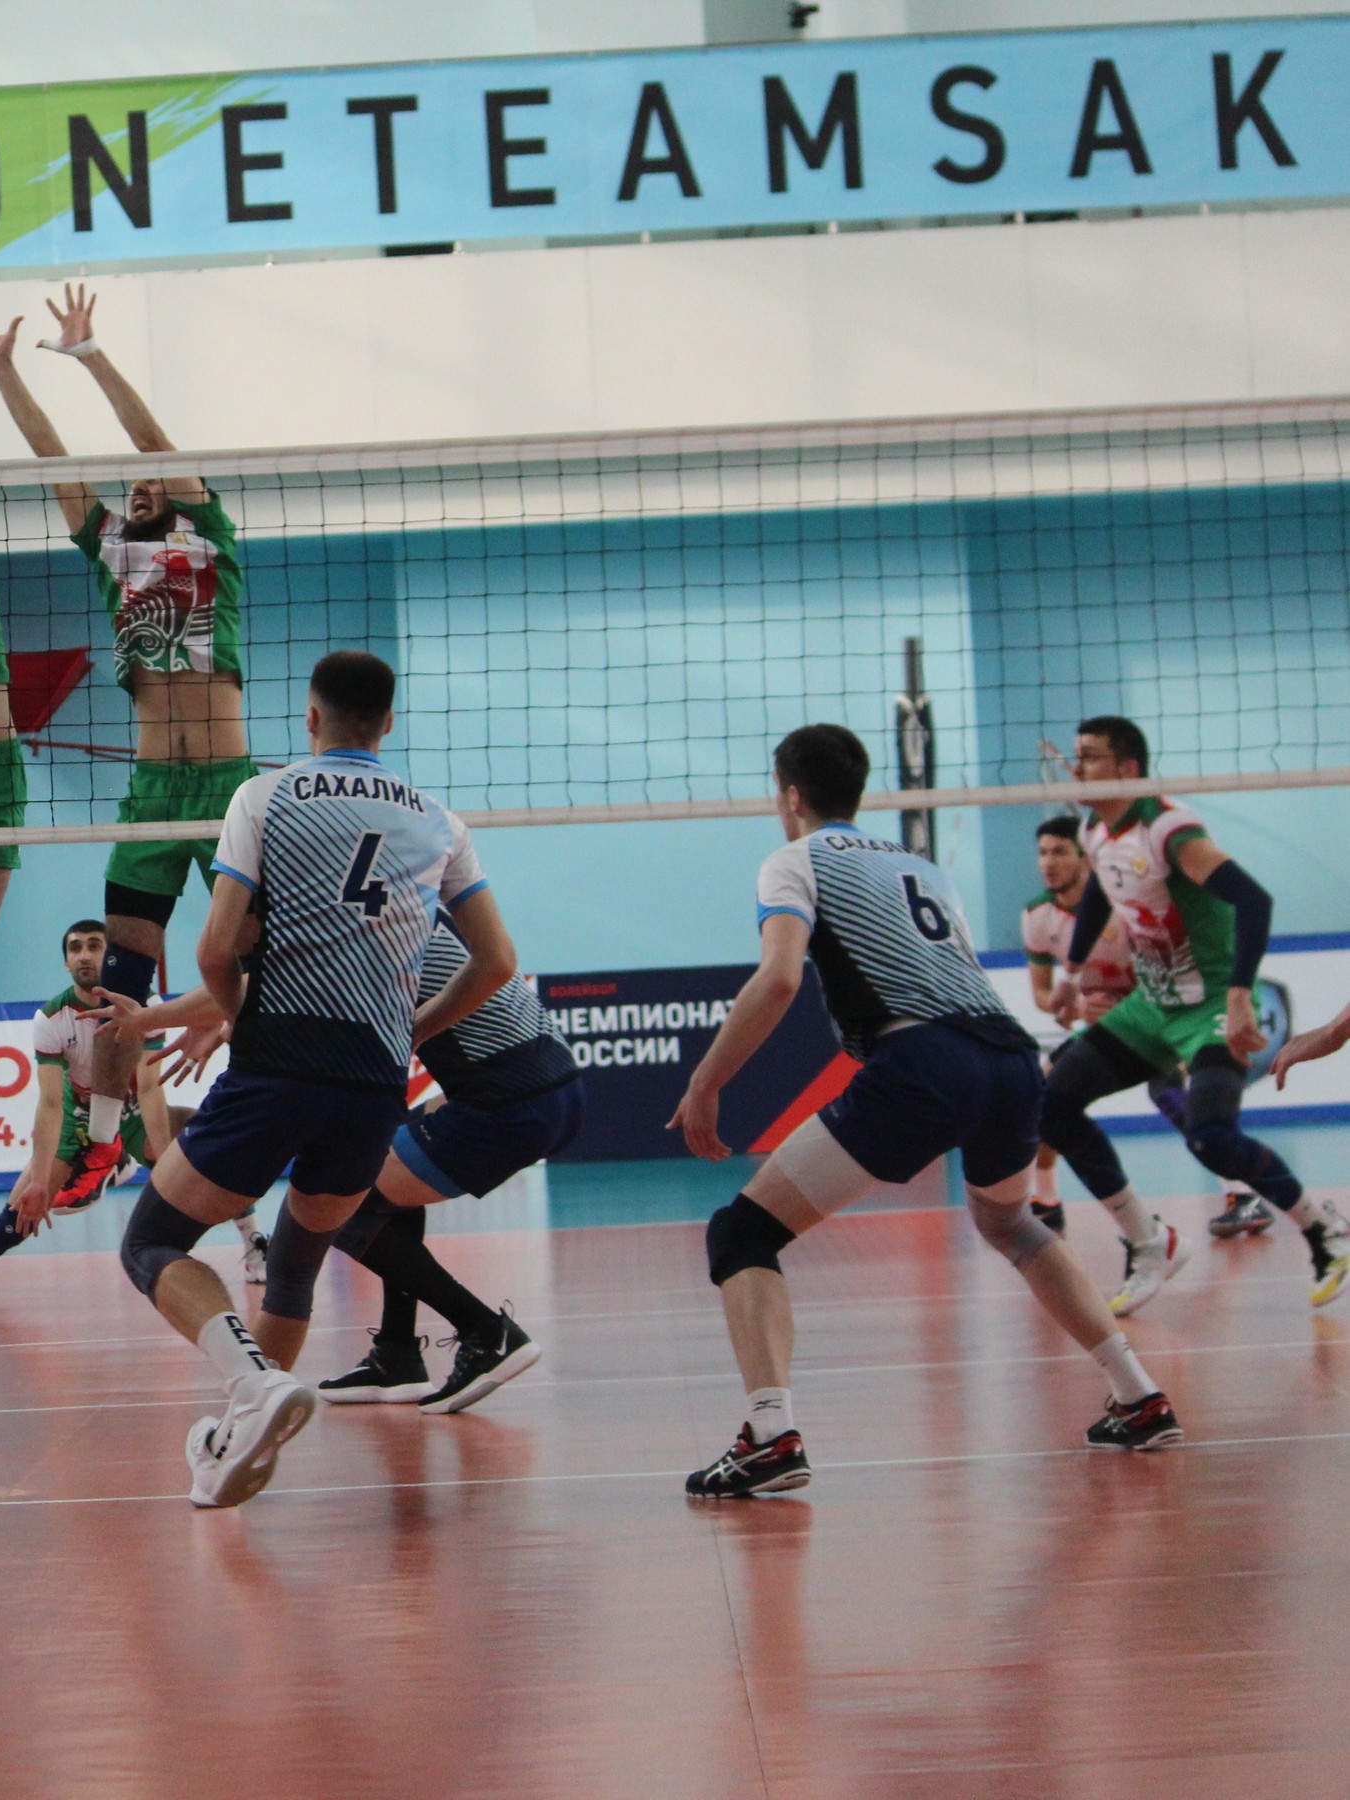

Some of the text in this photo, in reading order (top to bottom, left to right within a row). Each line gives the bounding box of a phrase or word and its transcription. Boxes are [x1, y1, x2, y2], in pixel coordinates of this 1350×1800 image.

[294, 773, 425, 813] САХАЛИН
[341, 832, 389, 918] 4
[902, 873, 951, 942] 6
[572, 1036, 681, 1068] ОССИИ
